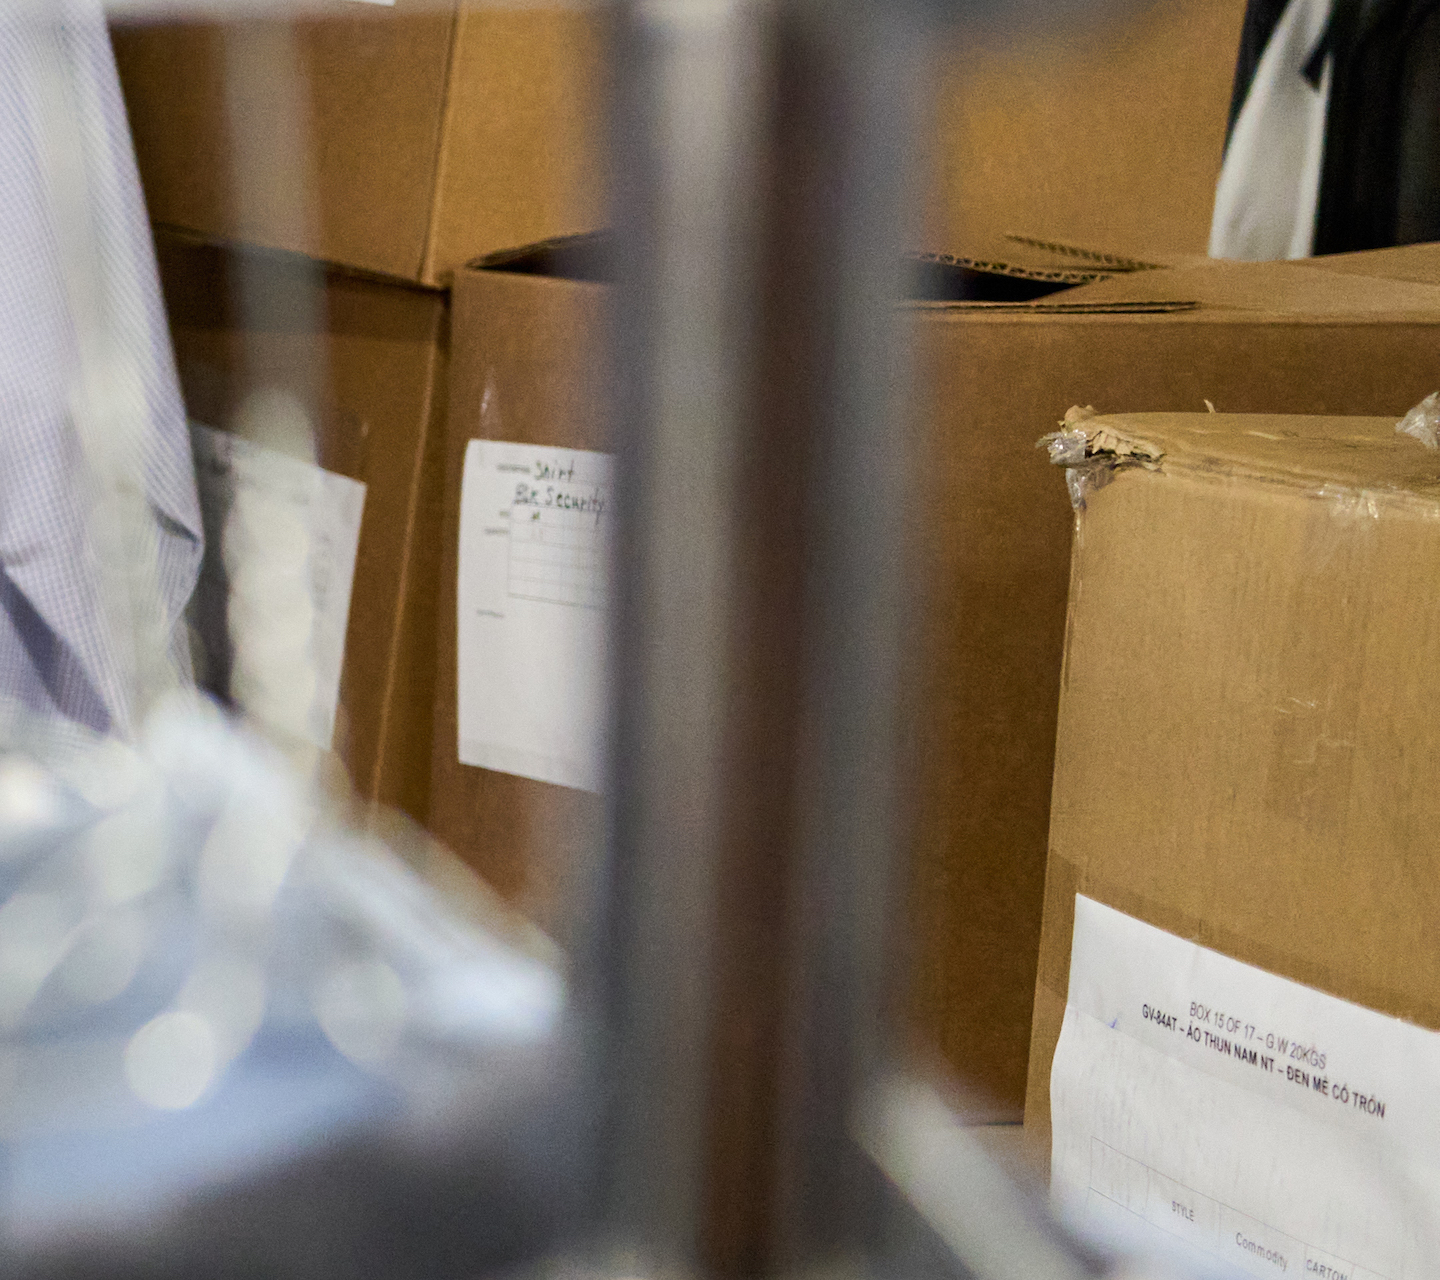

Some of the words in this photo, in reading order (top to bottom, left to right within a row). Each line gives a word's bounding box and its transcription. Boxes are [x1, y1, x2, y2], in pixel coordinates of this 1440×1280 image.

[1189, 1001, 1212, 1024] BOX
[1215, 1011, 1225, 1029] 15
[1226, 1017, 1241, 1033] OF
[1244, 1024, 1256, 1040] 17
[1290, 1042, 1327, 1070] 20KGS
[1203, 1030, 1231, 1056] THUN
[1234, 1043, 1258, 1067] NAM
[1260, 1055, 1275, 1073] NT
[1171, 1200, 1195, 1222] STYLE
[1235, 1232, 1288, 1272] Commodity
